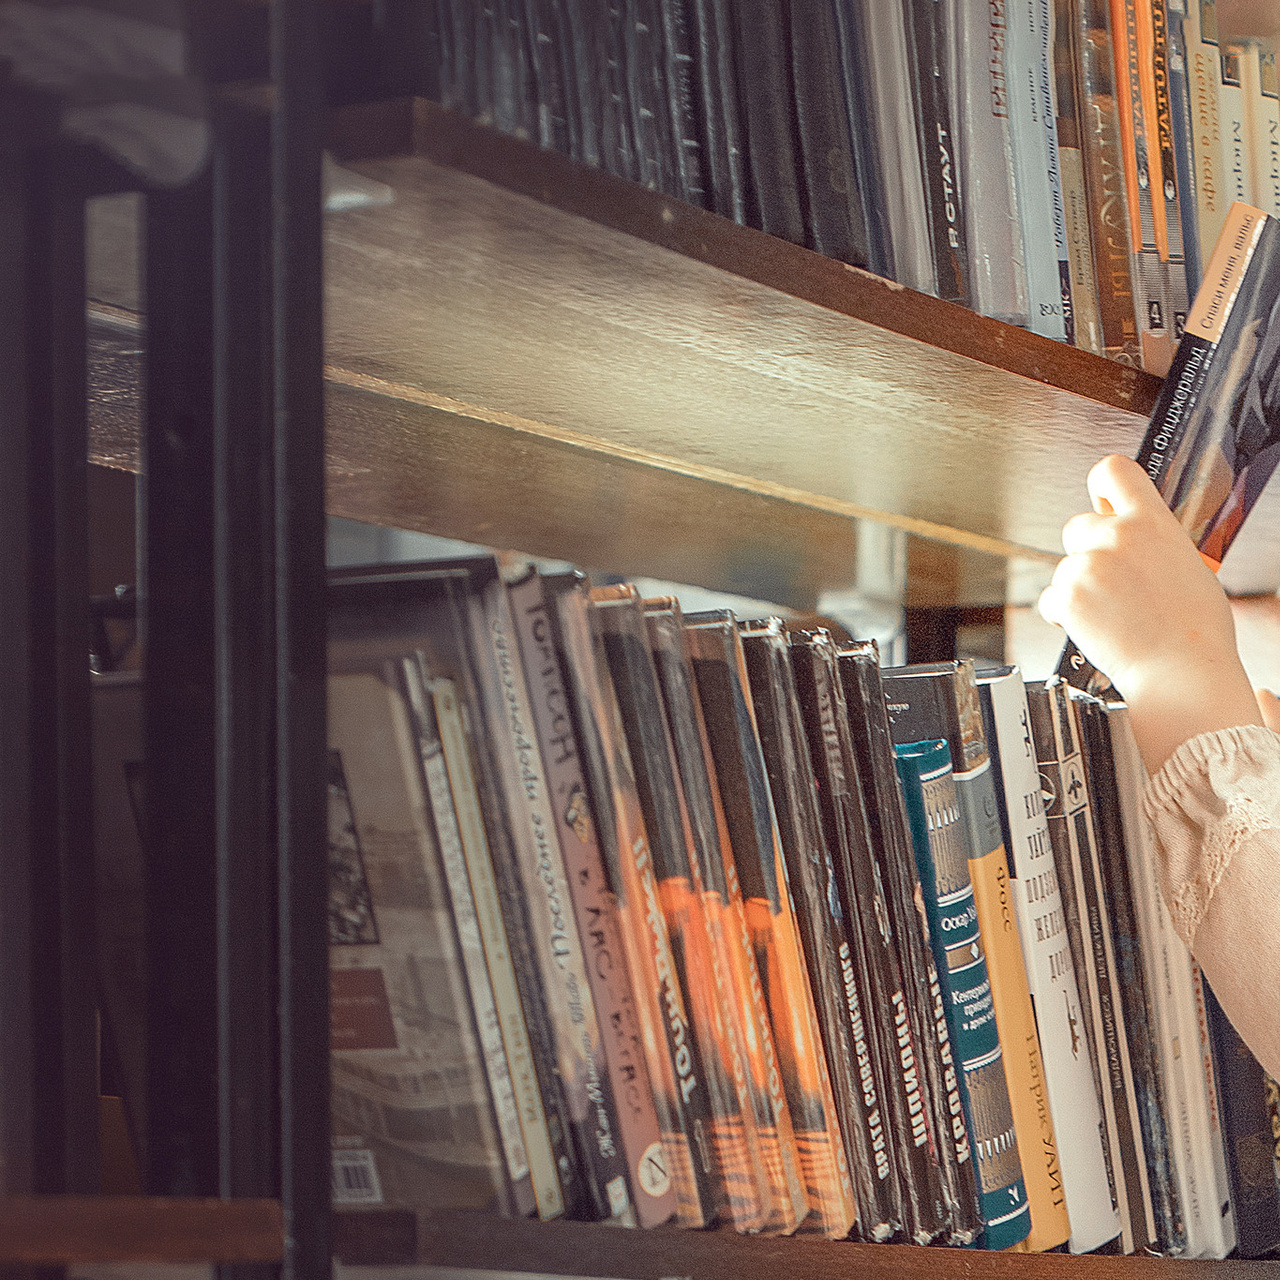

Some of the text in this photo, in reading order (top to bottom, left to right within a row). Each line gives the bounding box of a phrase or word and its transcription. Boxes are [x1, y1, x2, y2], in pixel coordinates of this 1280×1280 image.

[932, 120, 959, 223] СТАУТ
[1050, 189, 1066, 248] Роберт
[1197, 155, 1219, 213] кафе
[1198, 212, 1256, 331] Спаси меня, вальс
[1150, 344, 1211, 453] Фицджеральд
[484, 616, 573, 970] Последнее пророчество
[994, 866, 1015, 933] ФОСС
[835, 941, 890, 1179] ВРАТА СОВЕРШЕННОГО
[888, 989, 928, 1147] ШПИОНЫ
[921, 959, 971, 1164] КРОВАВЫЕ
